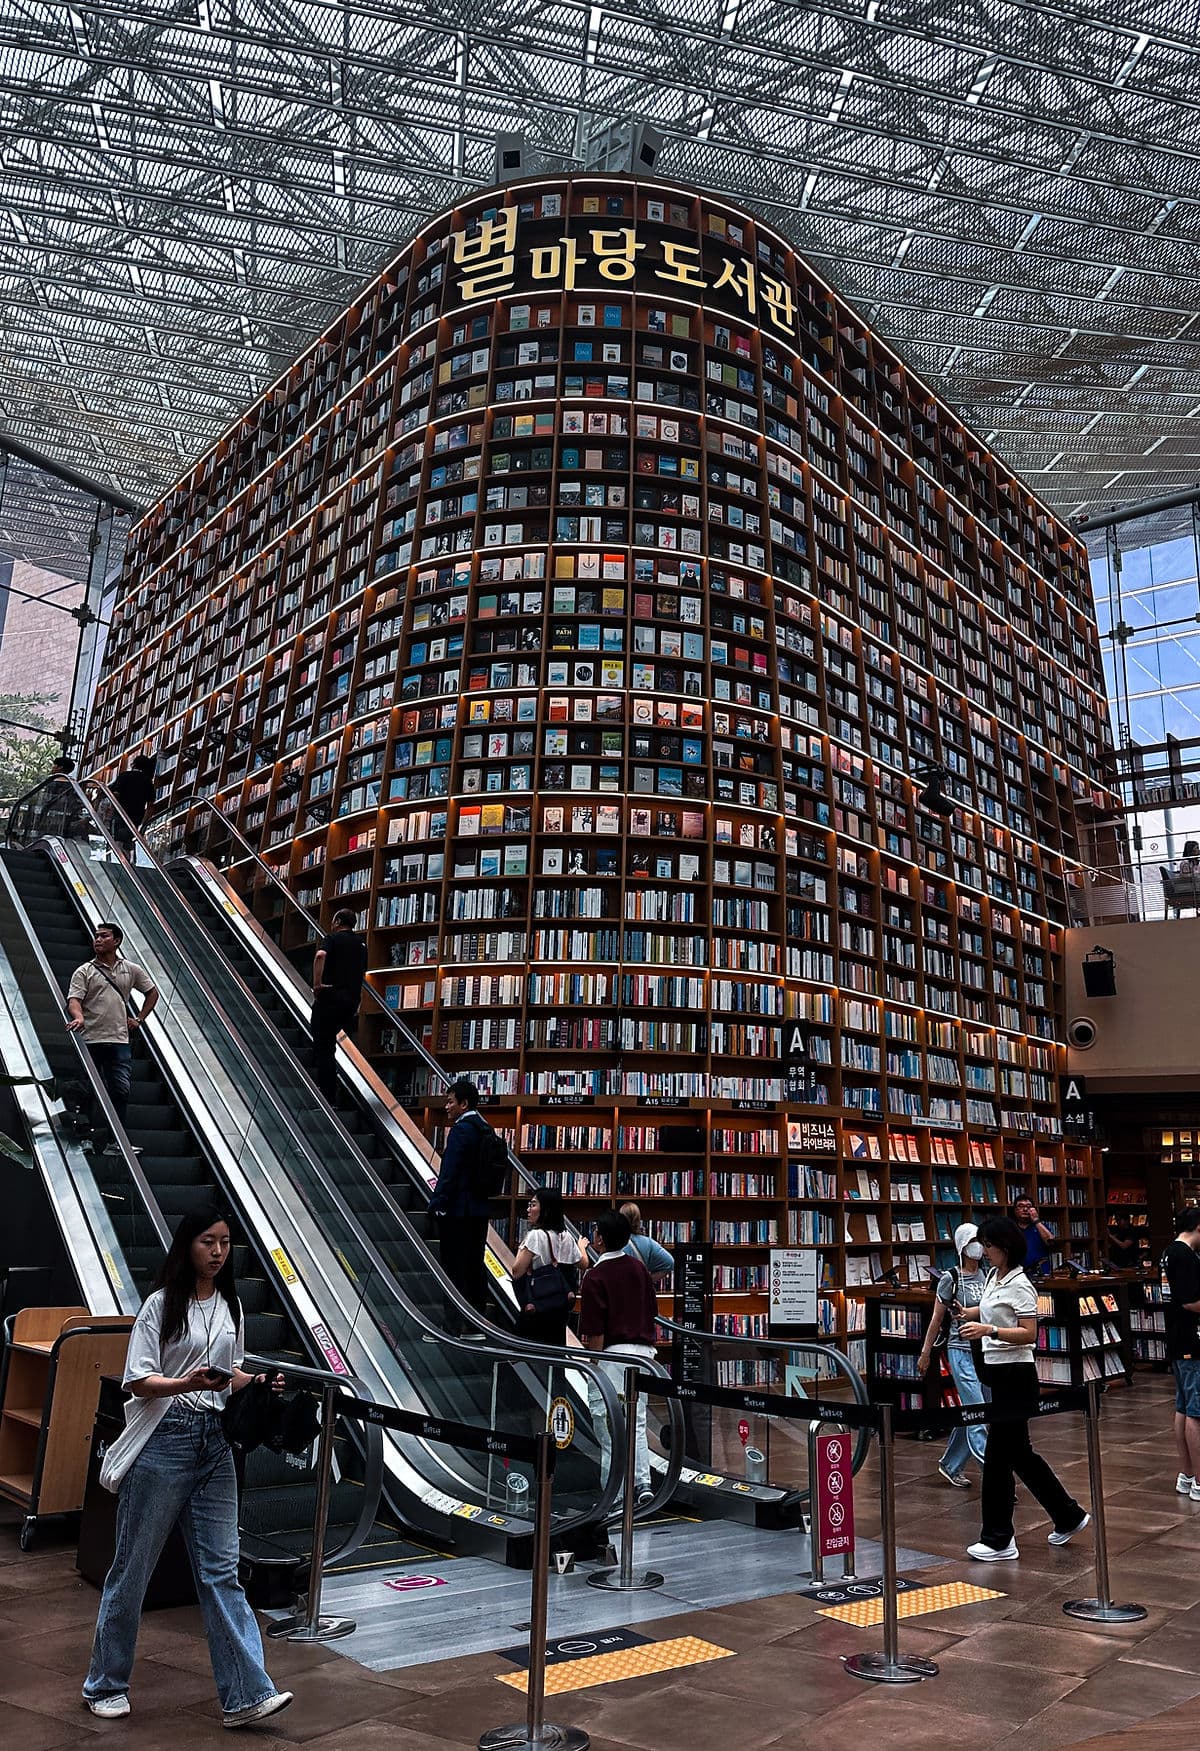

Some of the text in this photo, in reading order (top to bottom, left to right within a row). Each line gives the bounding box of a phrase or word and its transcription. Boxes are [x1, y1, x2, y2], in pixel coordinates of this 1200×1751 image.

[789, 1027, 805, 1053] A
[1065, 1080, 1081, 1100] A
[645, 1097, 659, 1105] A15
[1065, 1113, 1085, 1124] 소설
[801, 1122, 835, 1137] 비즈니스
[802, 1137, 837, 1151] 라이브러리
